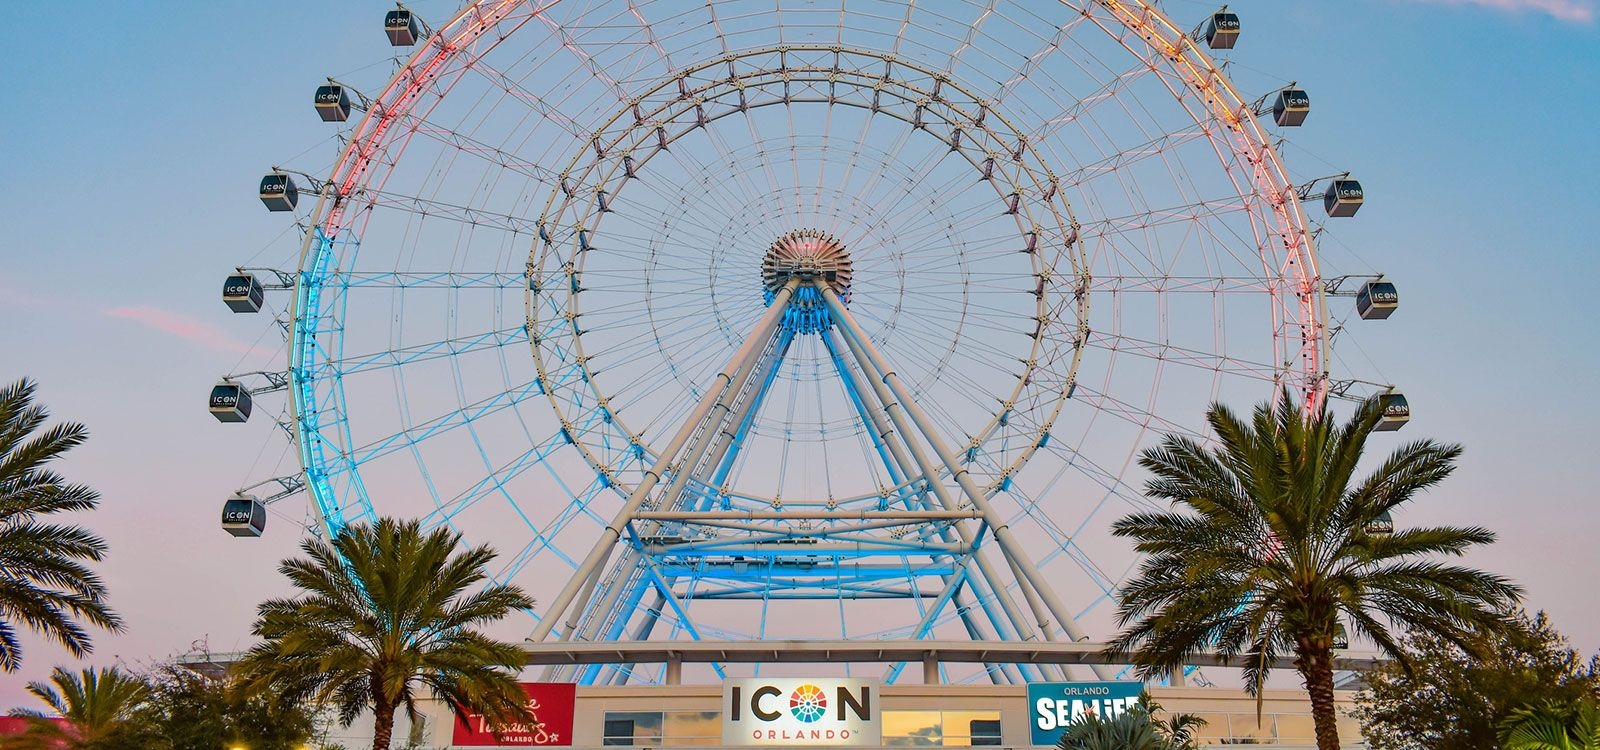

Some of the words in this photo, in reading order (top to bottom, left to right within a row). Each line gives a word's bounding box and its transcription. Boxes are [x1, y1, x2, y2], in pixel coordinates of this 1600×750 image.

[226, 511, 250, 519] ICON
[1063, 686, 1110, 696] ORLANDO
[731, 683, 871, 723] ICON
[1036, 697, 1089, 731] SEA
[500, 735, 533, 743] ORLANDO
[752, 729, 850, 740] ORLANDO
